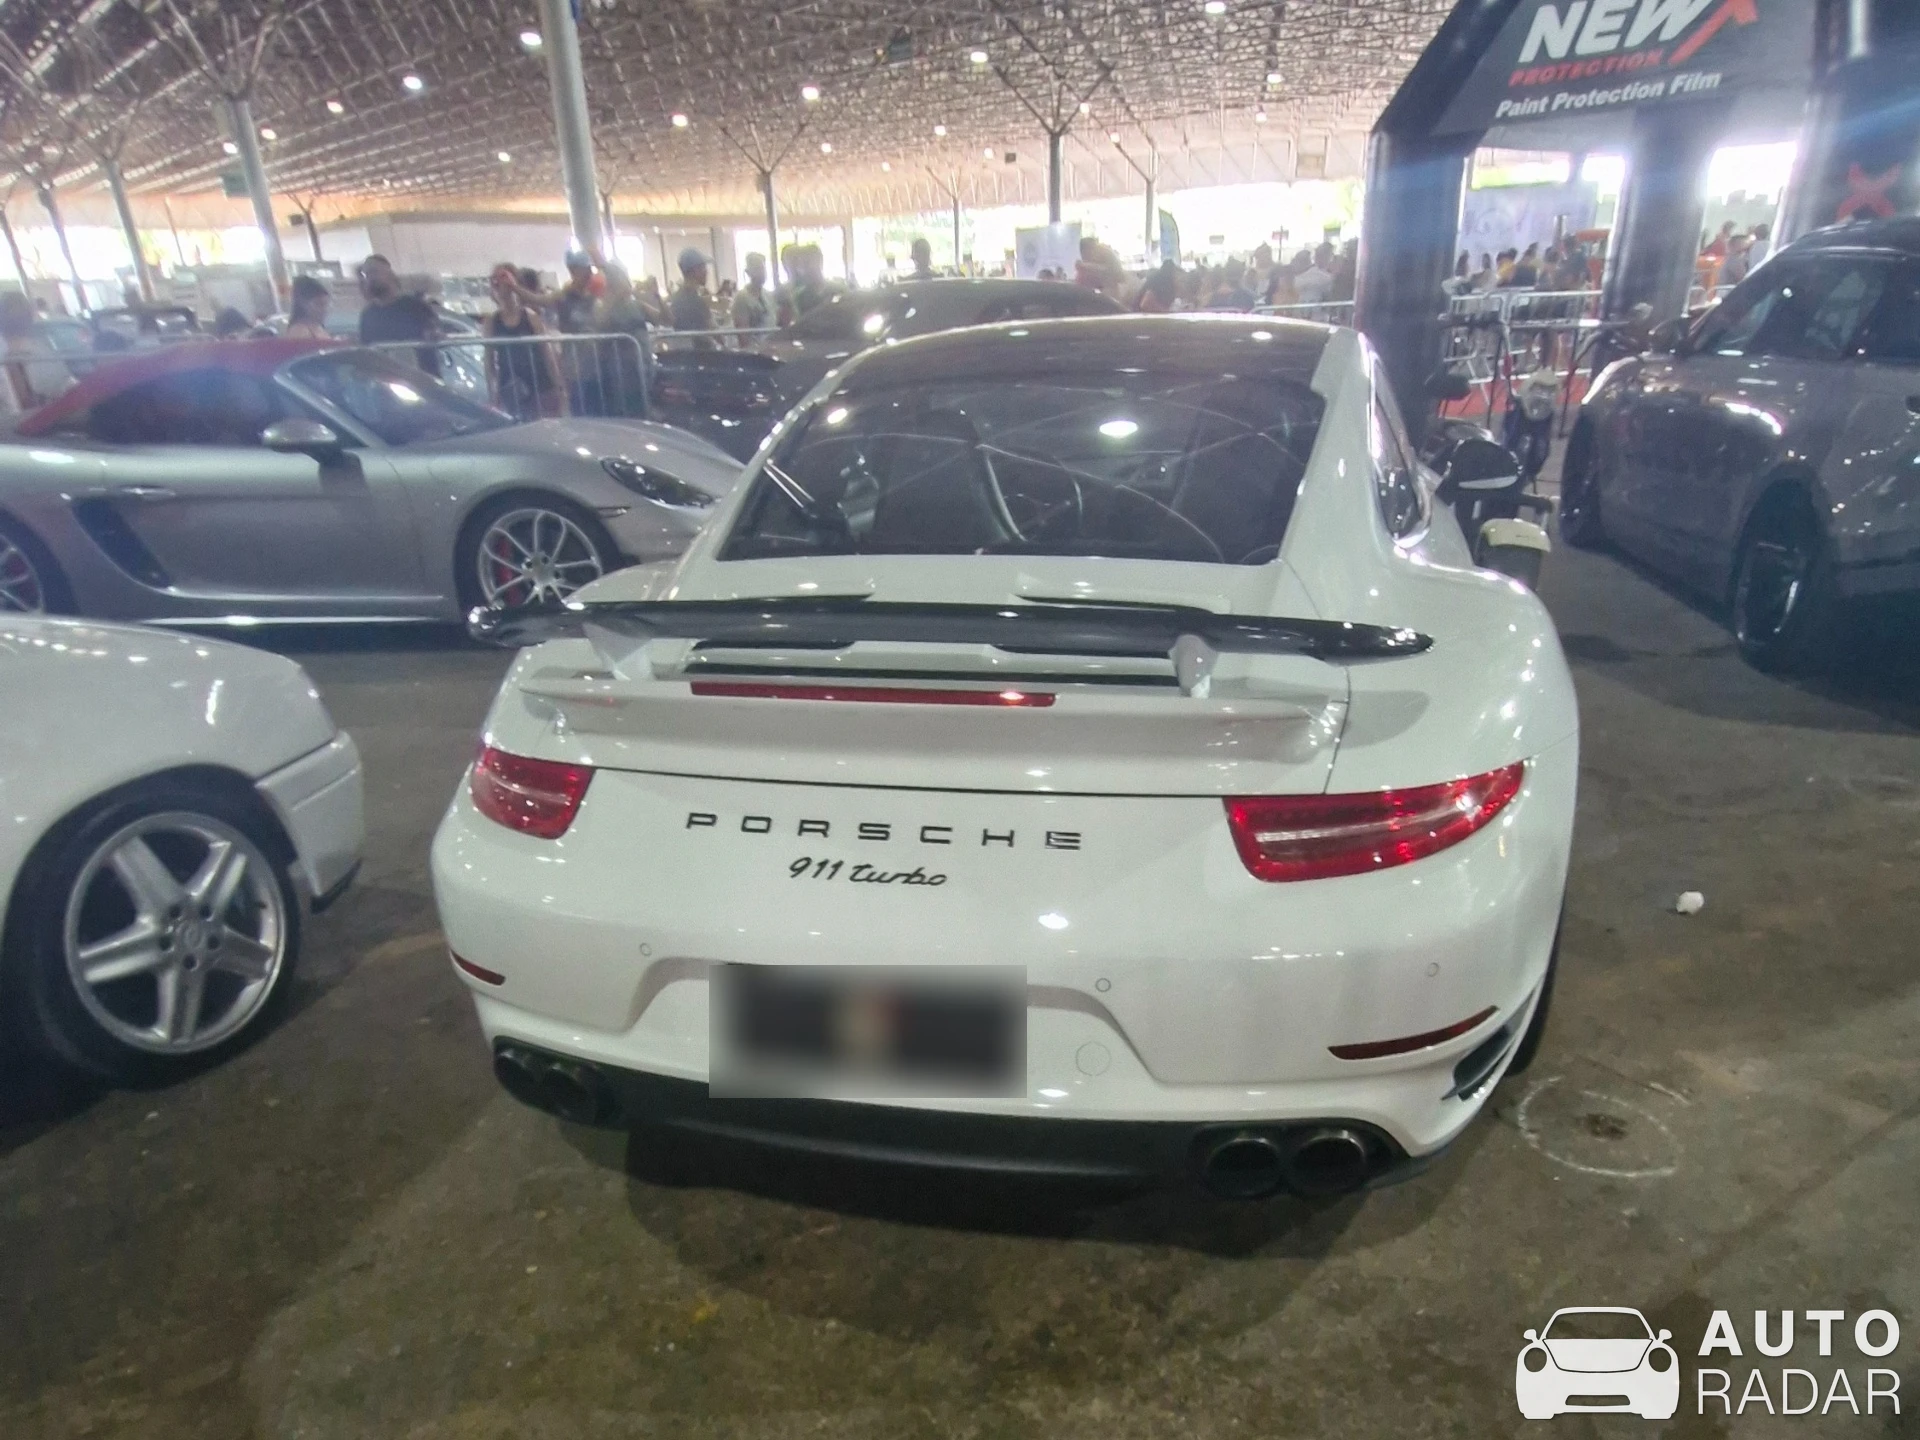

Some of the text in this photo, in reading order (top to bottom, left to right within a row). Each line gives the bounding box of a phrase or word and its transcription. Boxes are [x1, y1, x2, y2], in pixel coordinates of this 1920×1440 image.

[1507, 47, 1664, 88] PROTECTION
[1495, 72, 1723, 119] Paint Protection Film
[686, 812, 1082, 850] PORSCHE
[788, 856, 948, 887] 911 turbo
